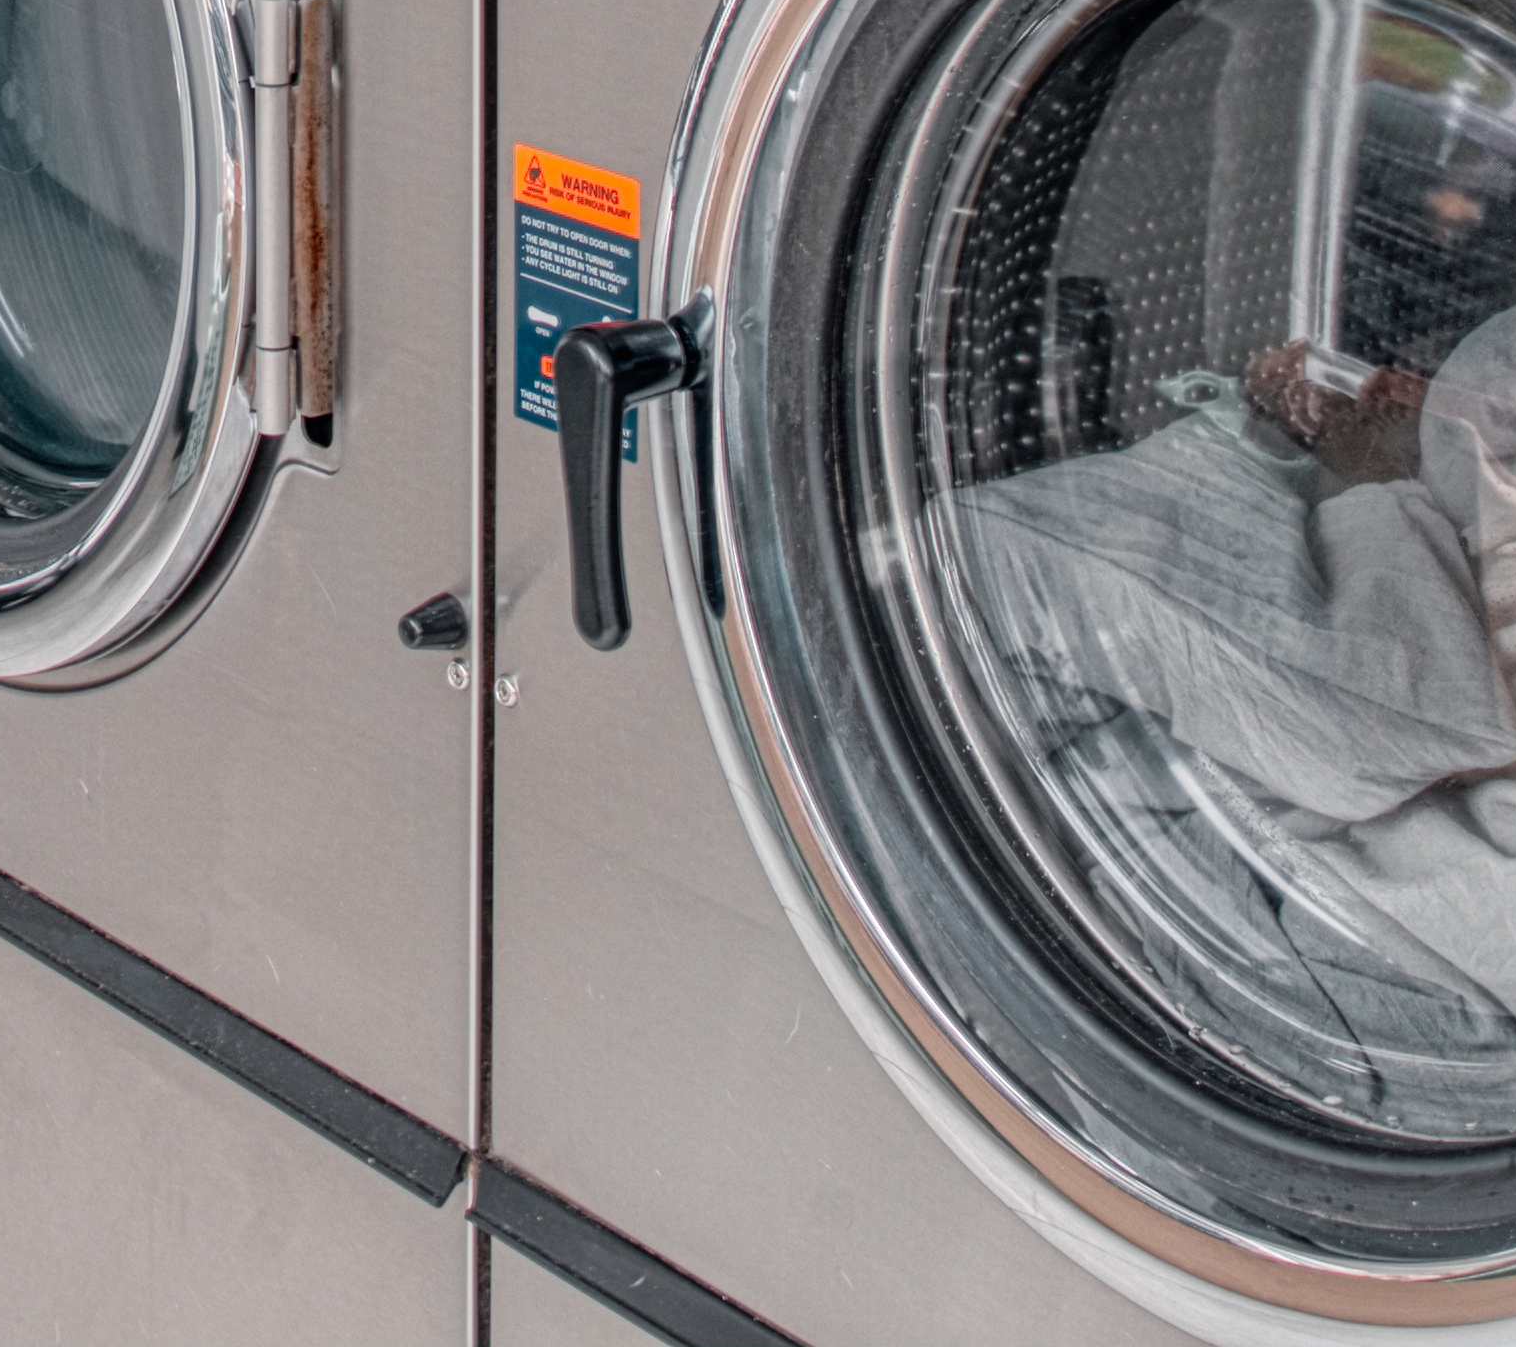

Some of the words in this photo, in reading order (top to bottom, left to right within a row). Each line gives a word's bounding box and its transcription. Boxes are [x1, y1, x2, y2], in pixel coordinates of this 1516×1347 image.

[561, 174, 619, 205] WARNING
[521, 215, 531, 225] DO
[532, 218, 545, 230] NOT
[546, 223, 559, 234] TRY
[560, 227, 569, 238] TO
[570, 231, 588, 244] OPEN
[589, 238, 608, 251] DOOR
[525, 233, 538, 244] THE
[539, 238, 557, 251] DRUM
[559, 245, 565, 253] IS
[566, 247, 583, 260] STILL
[585, 252, 614, 270] TURNING
[525, 244, 539, 256] YOU
[540, 249, 552, 260] SEE
[554, 253, 576, 268] WATER
[578, 261, 584, 271] IN
[586, 263, 598, 276] THE
[599, 269, 628, 286] WINDOW
[525, 256, 539, 267] ANY
[539, 260, 560, 275] CYCLE
[562, 267, 580, 281] LIGHT
[581, 274, 587, 284] IS
[589, 277, 607, 290] STILL
[608, 283, 618, 294] ON
[520, 388, 541, 403] THERE
[522, 400, 545, 417] BEFORE
